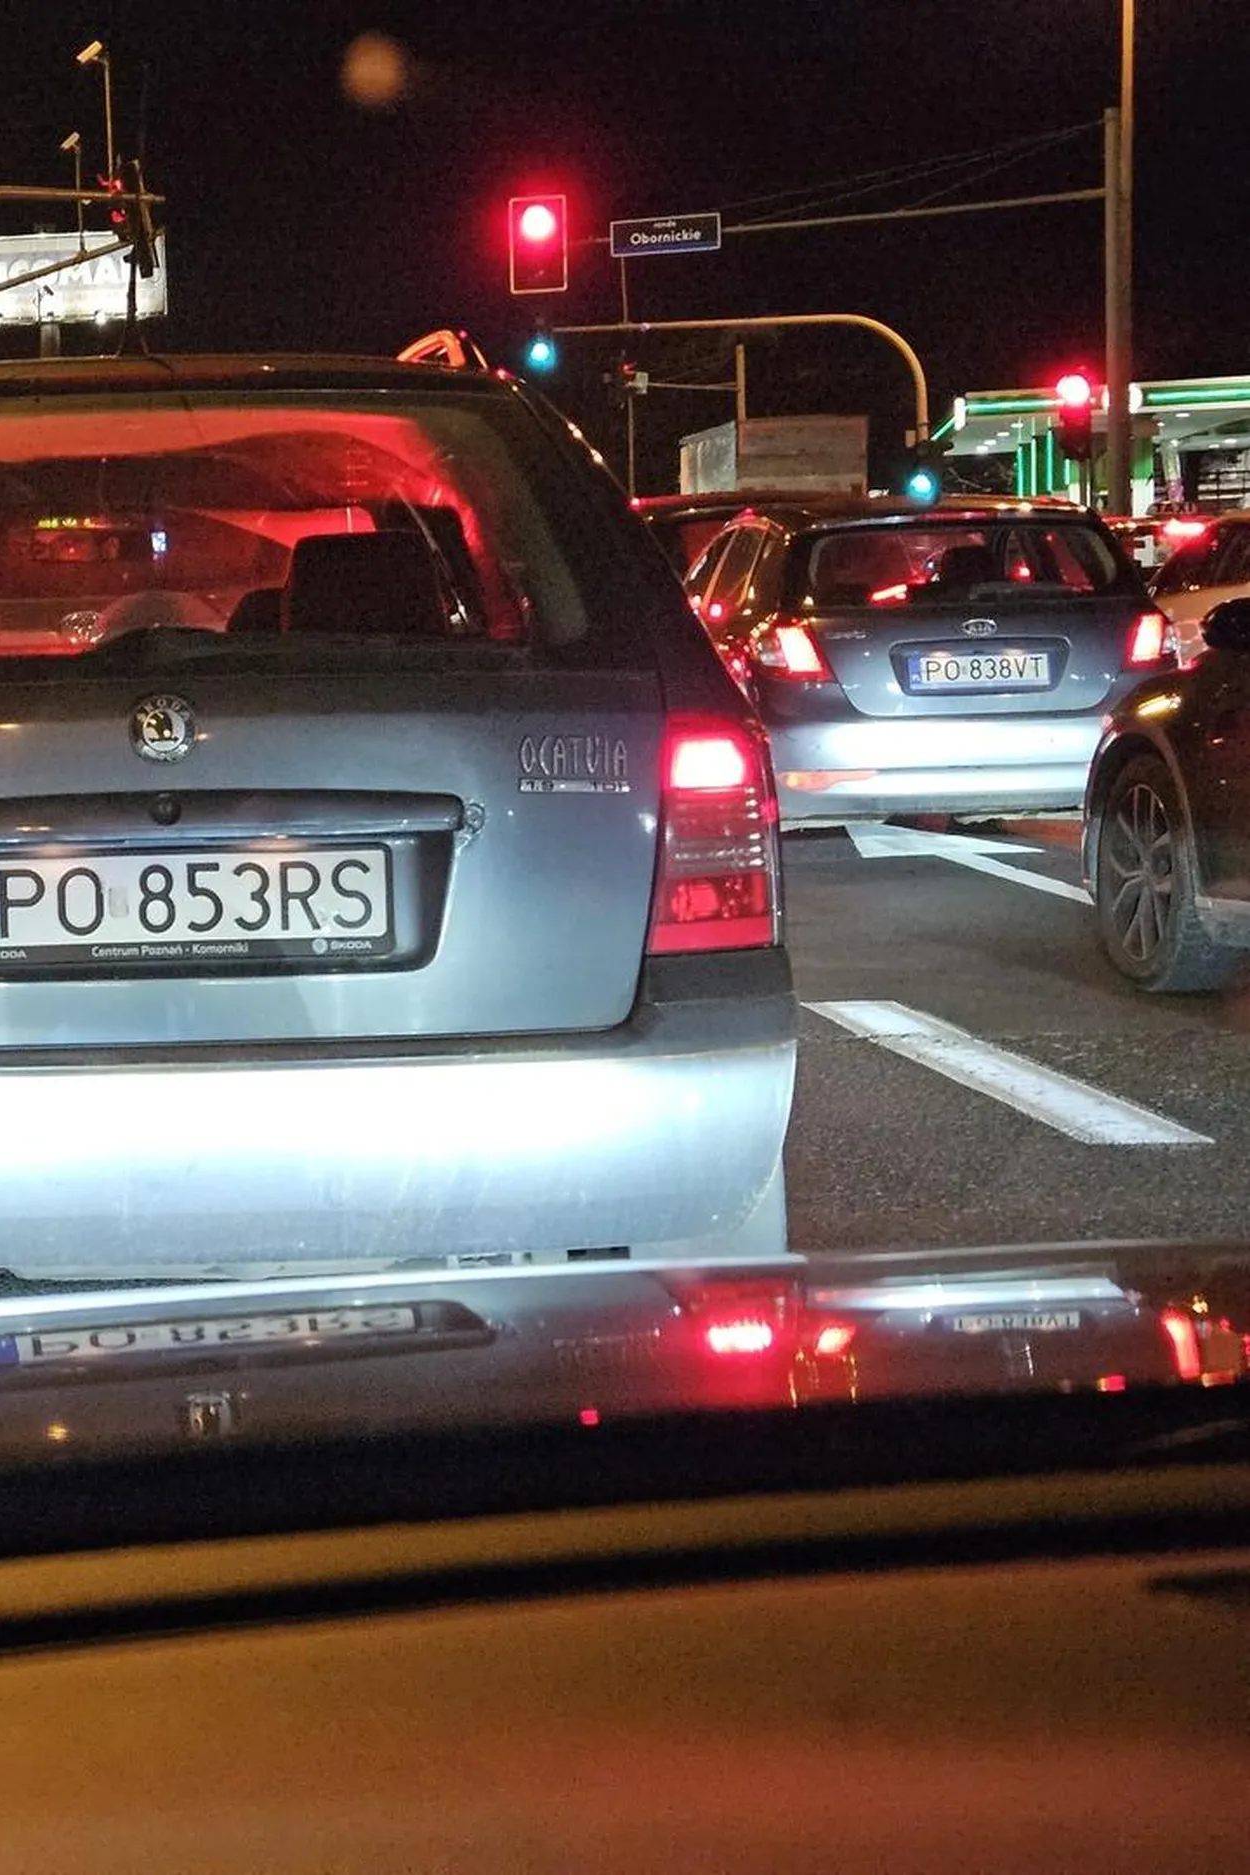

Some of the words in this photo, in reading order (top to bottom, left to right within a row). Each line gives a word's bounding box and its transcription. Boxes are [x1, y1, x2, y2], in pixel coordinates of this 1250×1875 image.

[630, 228, 702, 245] Obornickie
[926, 661, 960, 681] PO
[970, 656, 1043, 680] 838VT
[138, 859, 373, 934] 853RS
[91, 946, 139, 957] Centrum
[141, 944, 183, 956] Poznań
[192, 942, 249, 954] Komorniki
